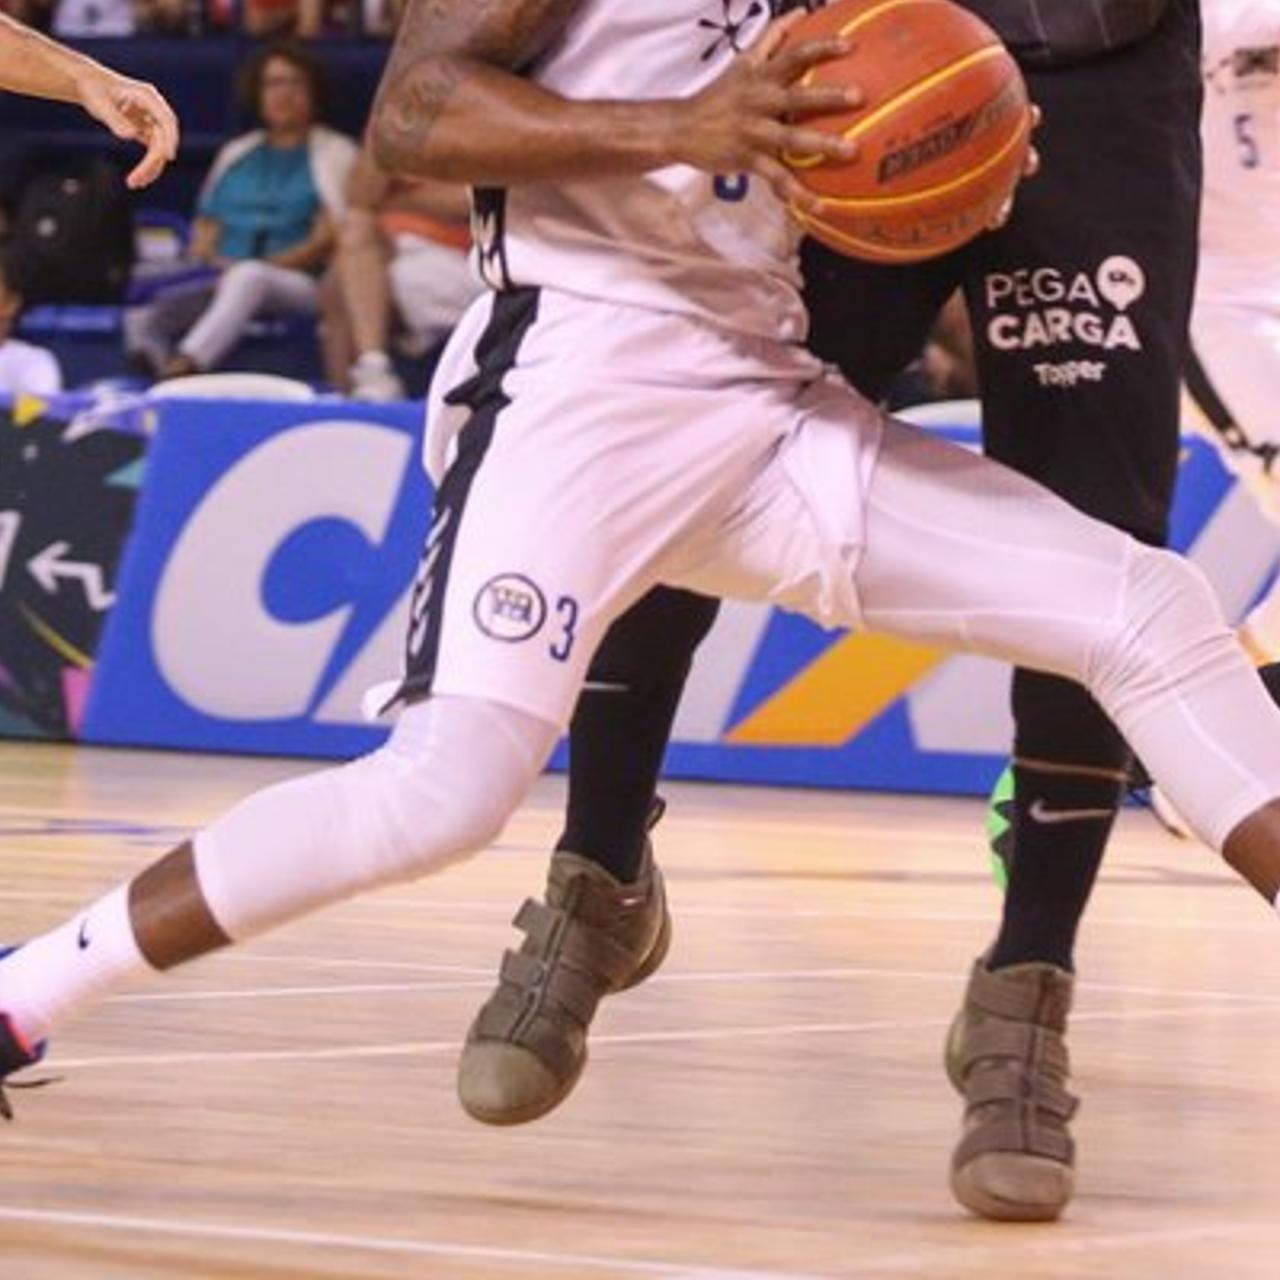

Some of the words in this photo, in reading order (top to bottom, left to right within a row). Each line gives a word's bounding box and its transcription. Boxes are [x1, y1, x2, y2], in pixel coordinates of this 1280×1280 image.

[1234, 113, 1259, 169] 5
[985, 267, 1100, 308] PEGA
[987, 307, 1142, 351] CARGA
[549, 595, 579, 663] 3
